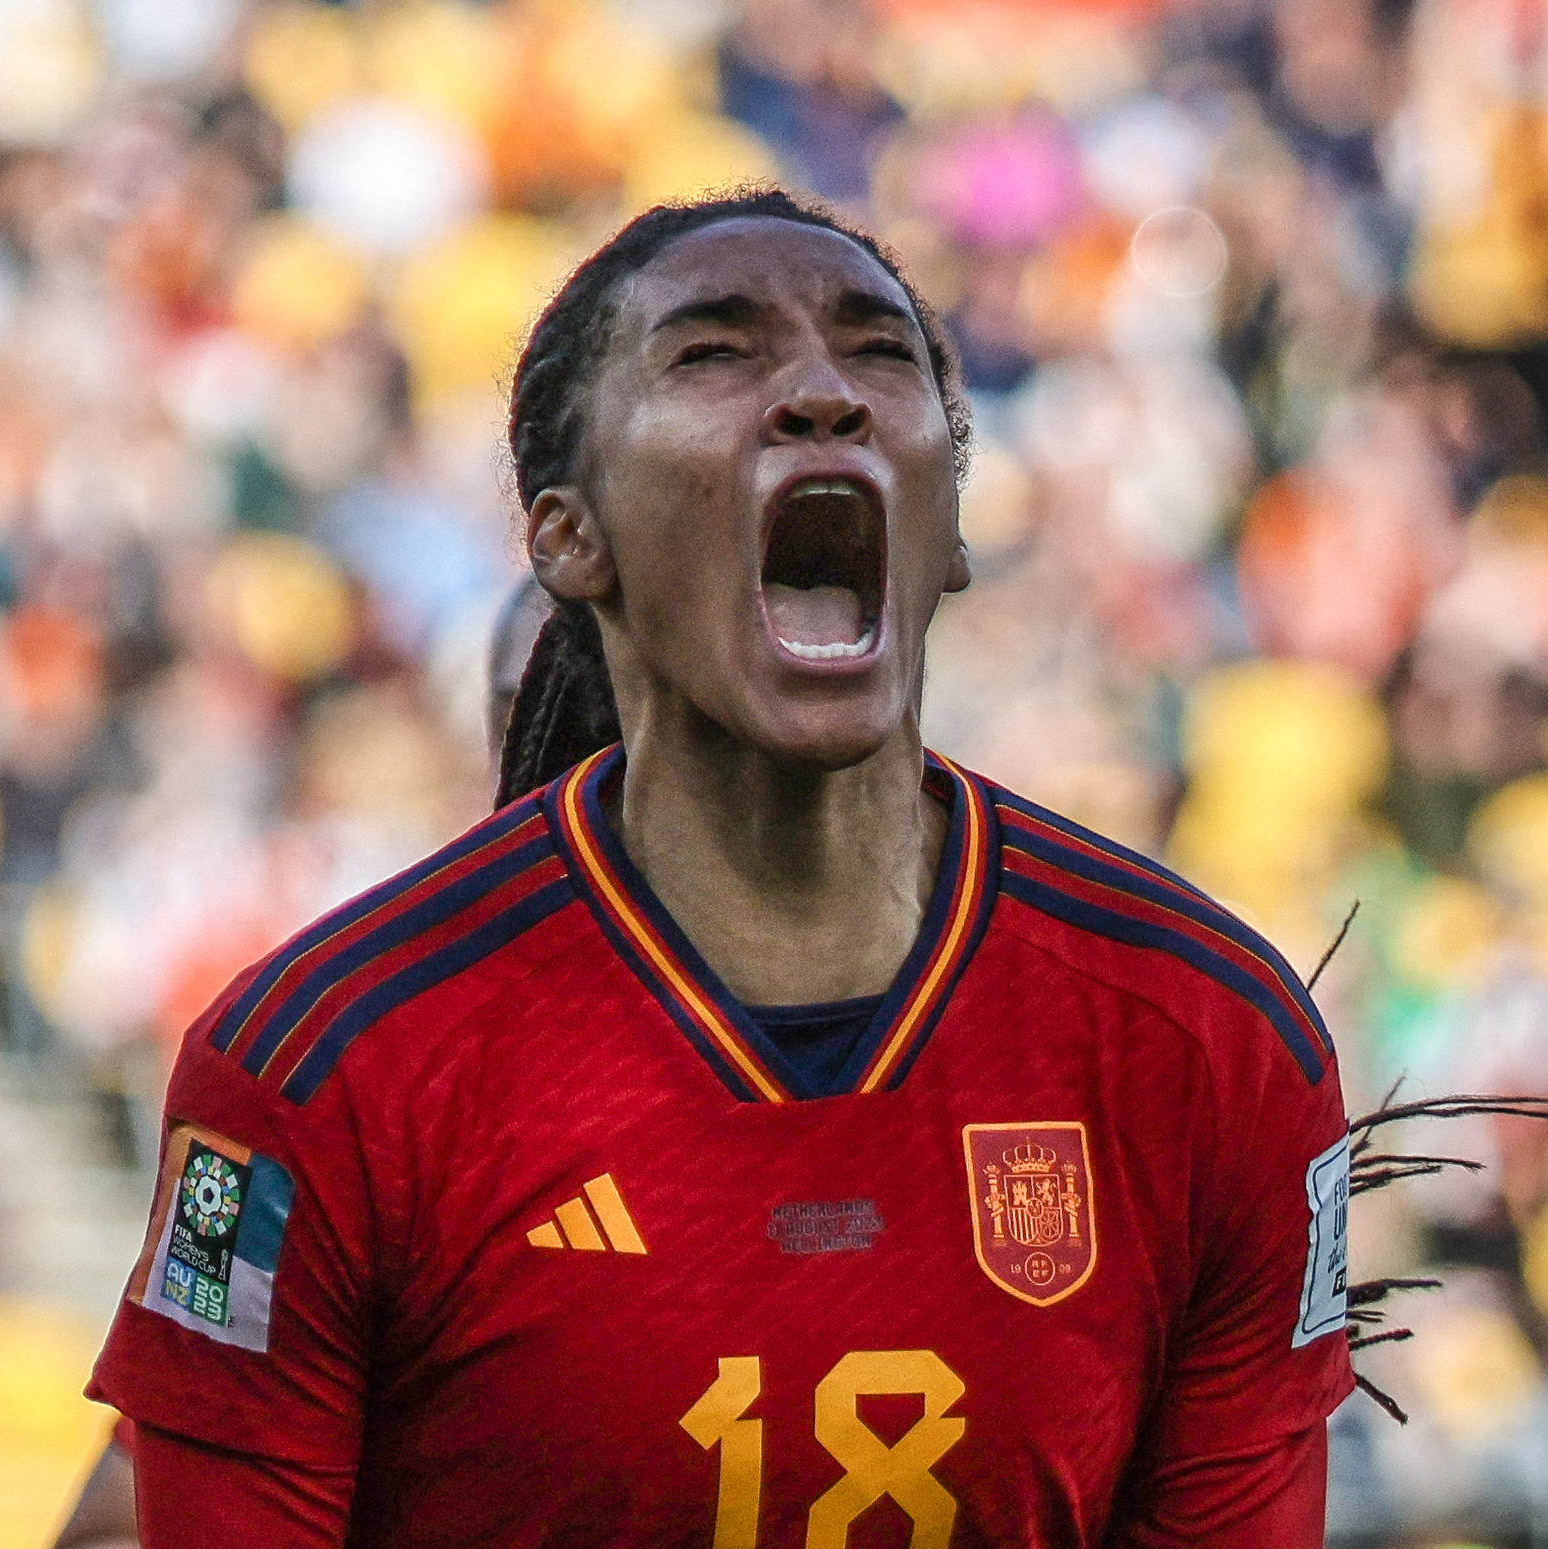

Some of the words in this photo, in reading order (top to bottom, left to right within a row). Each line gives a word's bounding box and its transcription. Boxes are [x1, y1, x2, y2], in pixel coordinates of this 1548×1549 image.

[175, 1225, 192, 1242] FIFA
[167, 1263, 191, 1287] AU
[165, 1280, 189, 1306] NZ
